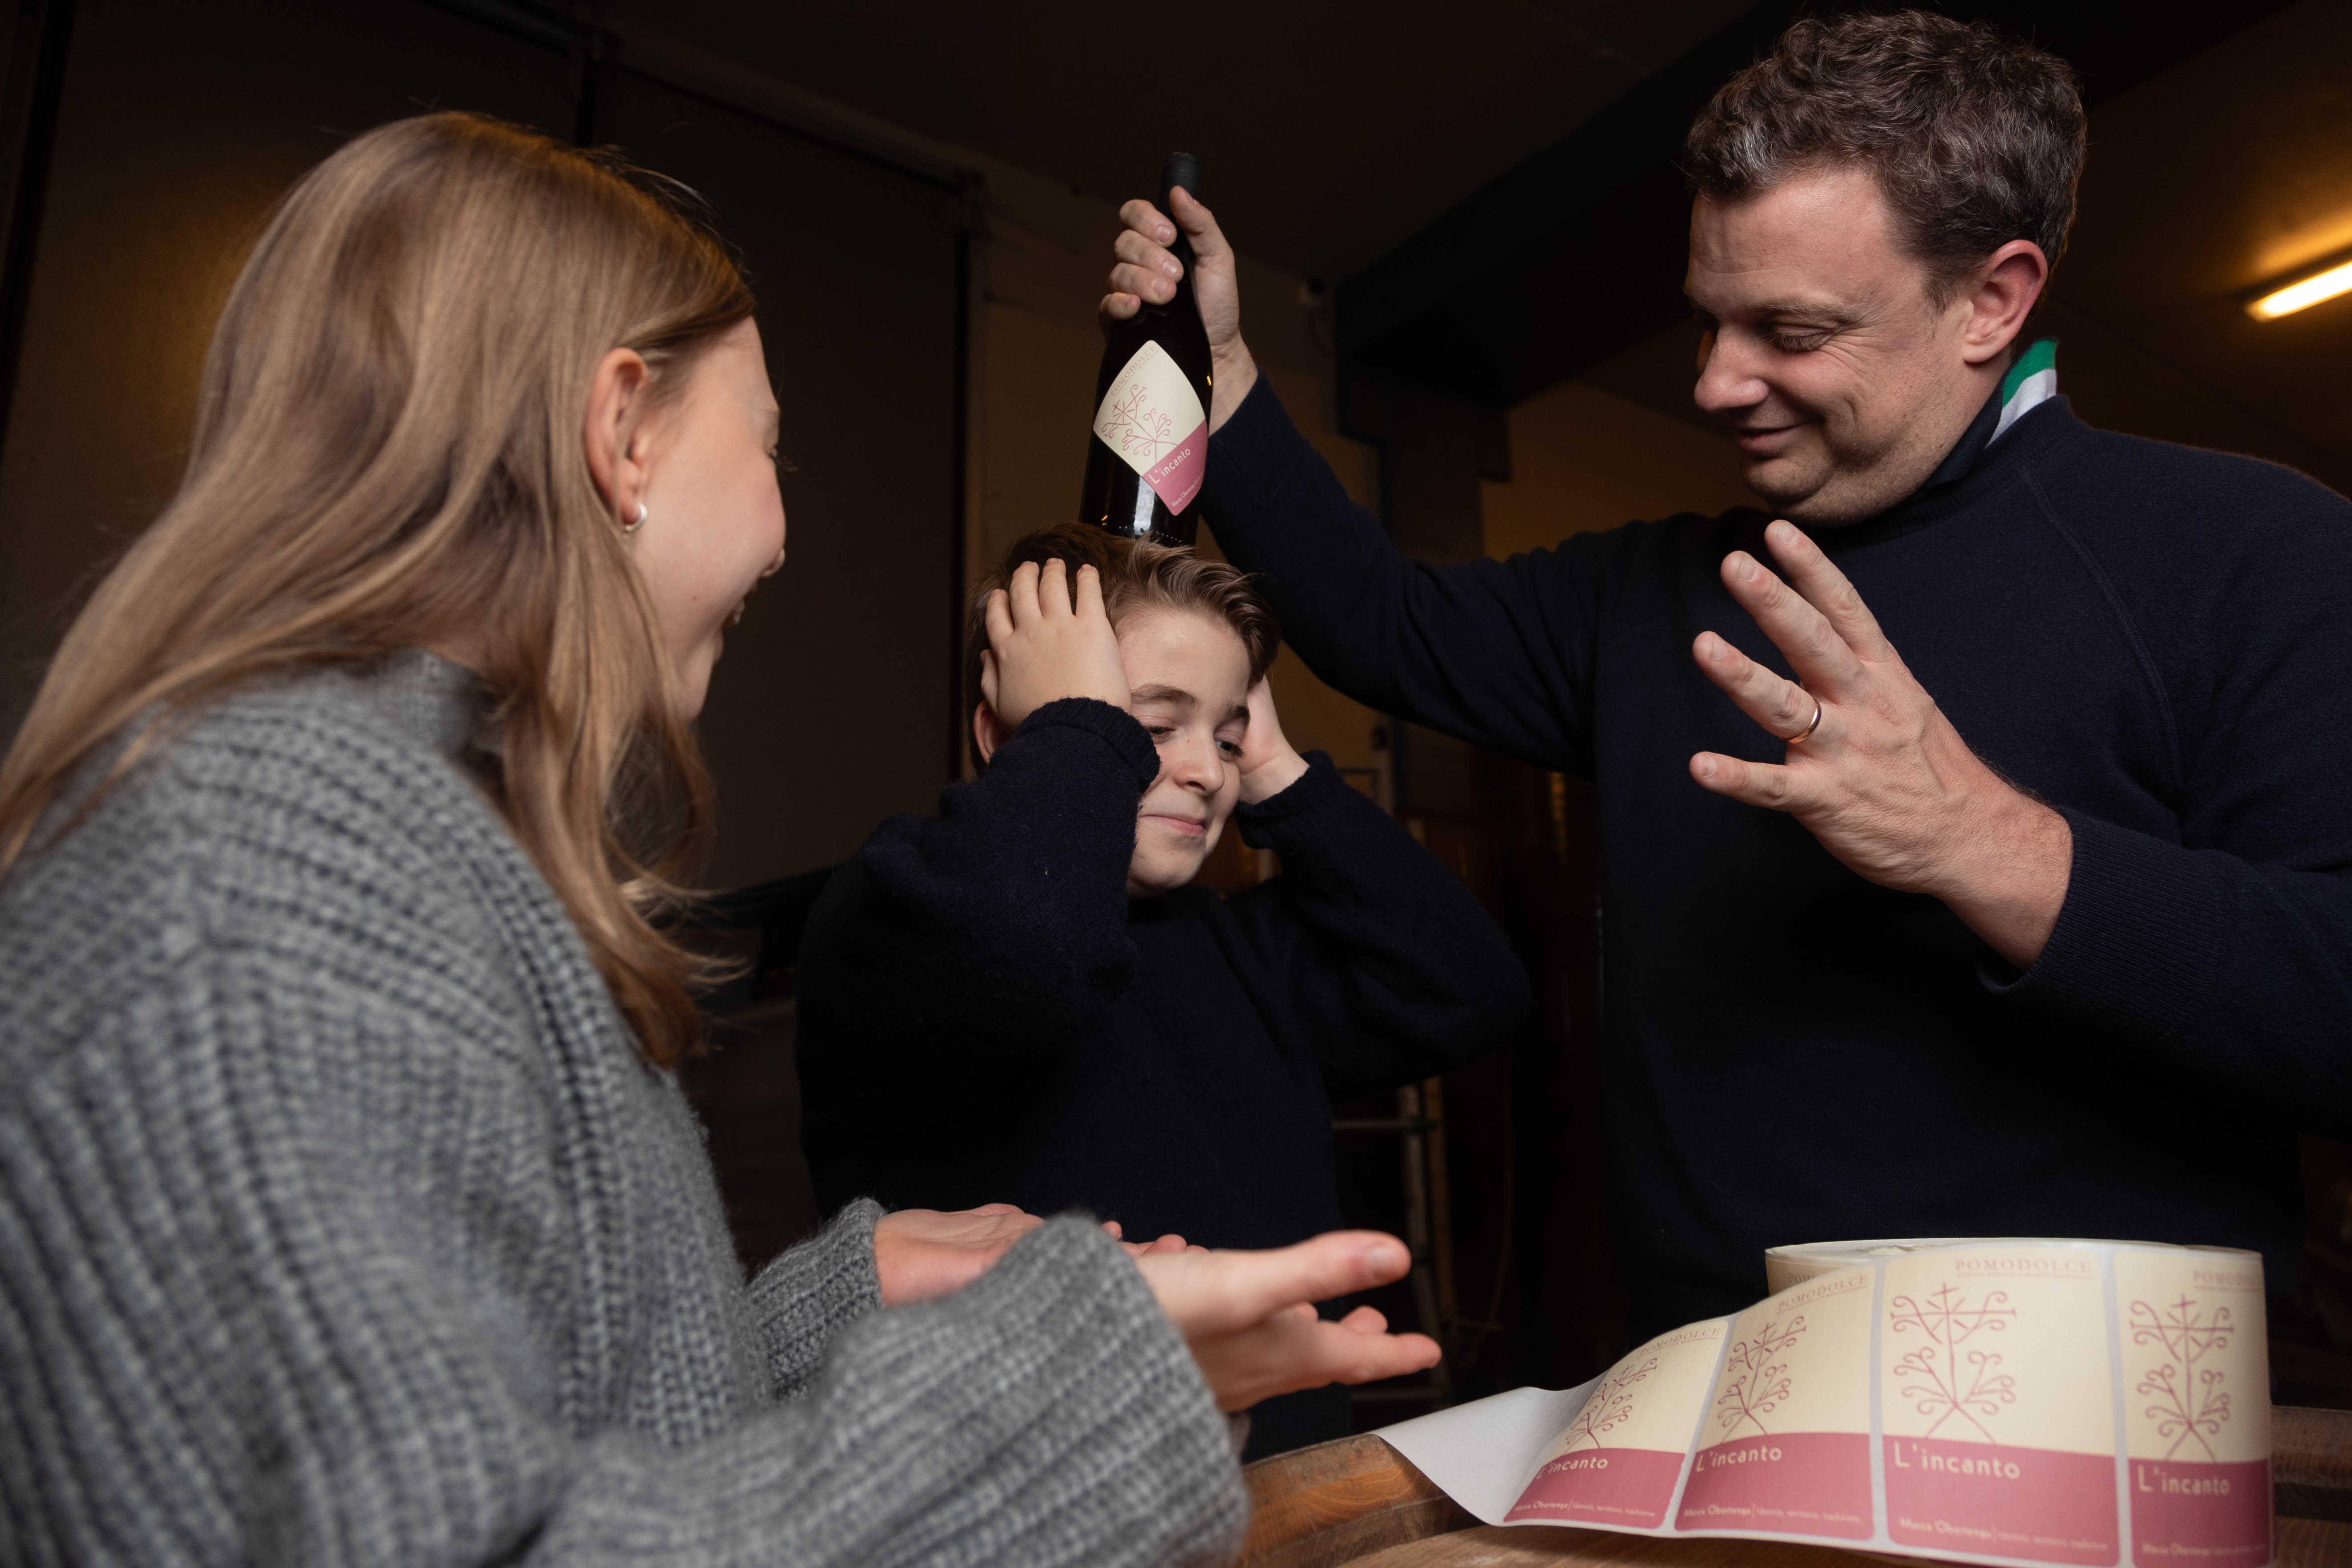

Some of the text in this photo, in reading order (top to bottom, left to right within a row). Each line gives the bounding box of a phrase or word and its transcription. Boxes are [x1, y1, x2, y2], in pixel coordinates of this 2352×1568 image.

[1111, 345, 1156, 396] POMODOLCE
[1148, 449, 1191, 484] L'incanto
[1956, 1258, 2093, 1273] POMODOLCE
[1779, 1275, 1868, 1310] POMODOLCE
[1640, 1328, 1720, 1355] POMODOLCE
[1536, 1456, 1608, 1480] L'incanto
[1696, 1444, 1782, 1472] L'incanto
[1894, 1442, 2021, 1479] L'incanto
[2137, 1465, 2231, 1495] L'incanto
